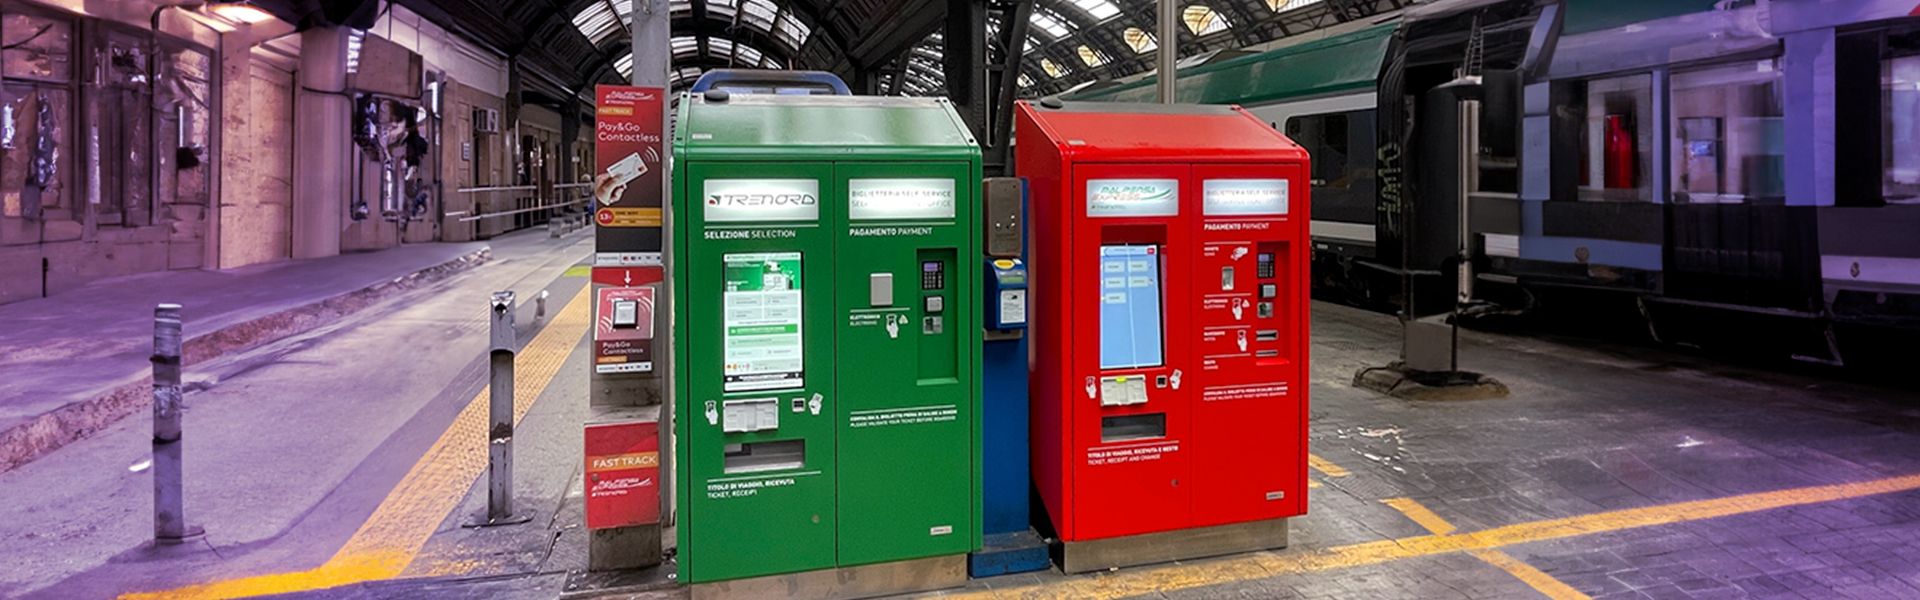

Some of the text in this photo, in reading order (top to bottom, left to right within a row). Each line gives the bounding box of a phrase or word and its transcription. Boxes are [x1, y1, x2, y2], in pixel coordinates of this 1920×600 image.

[598, 121, 640, 132] Pay&Go
[598, 131, 660, 142] Contactless
[723, 194, 816, 206] TRENORD
[704, 229, 796, 239] SELEZIONE SELECTION
[849, 227, 933, 237] PAGAMENTO PAYMENT
[593, 455, 656, 469] FAST TRACK
